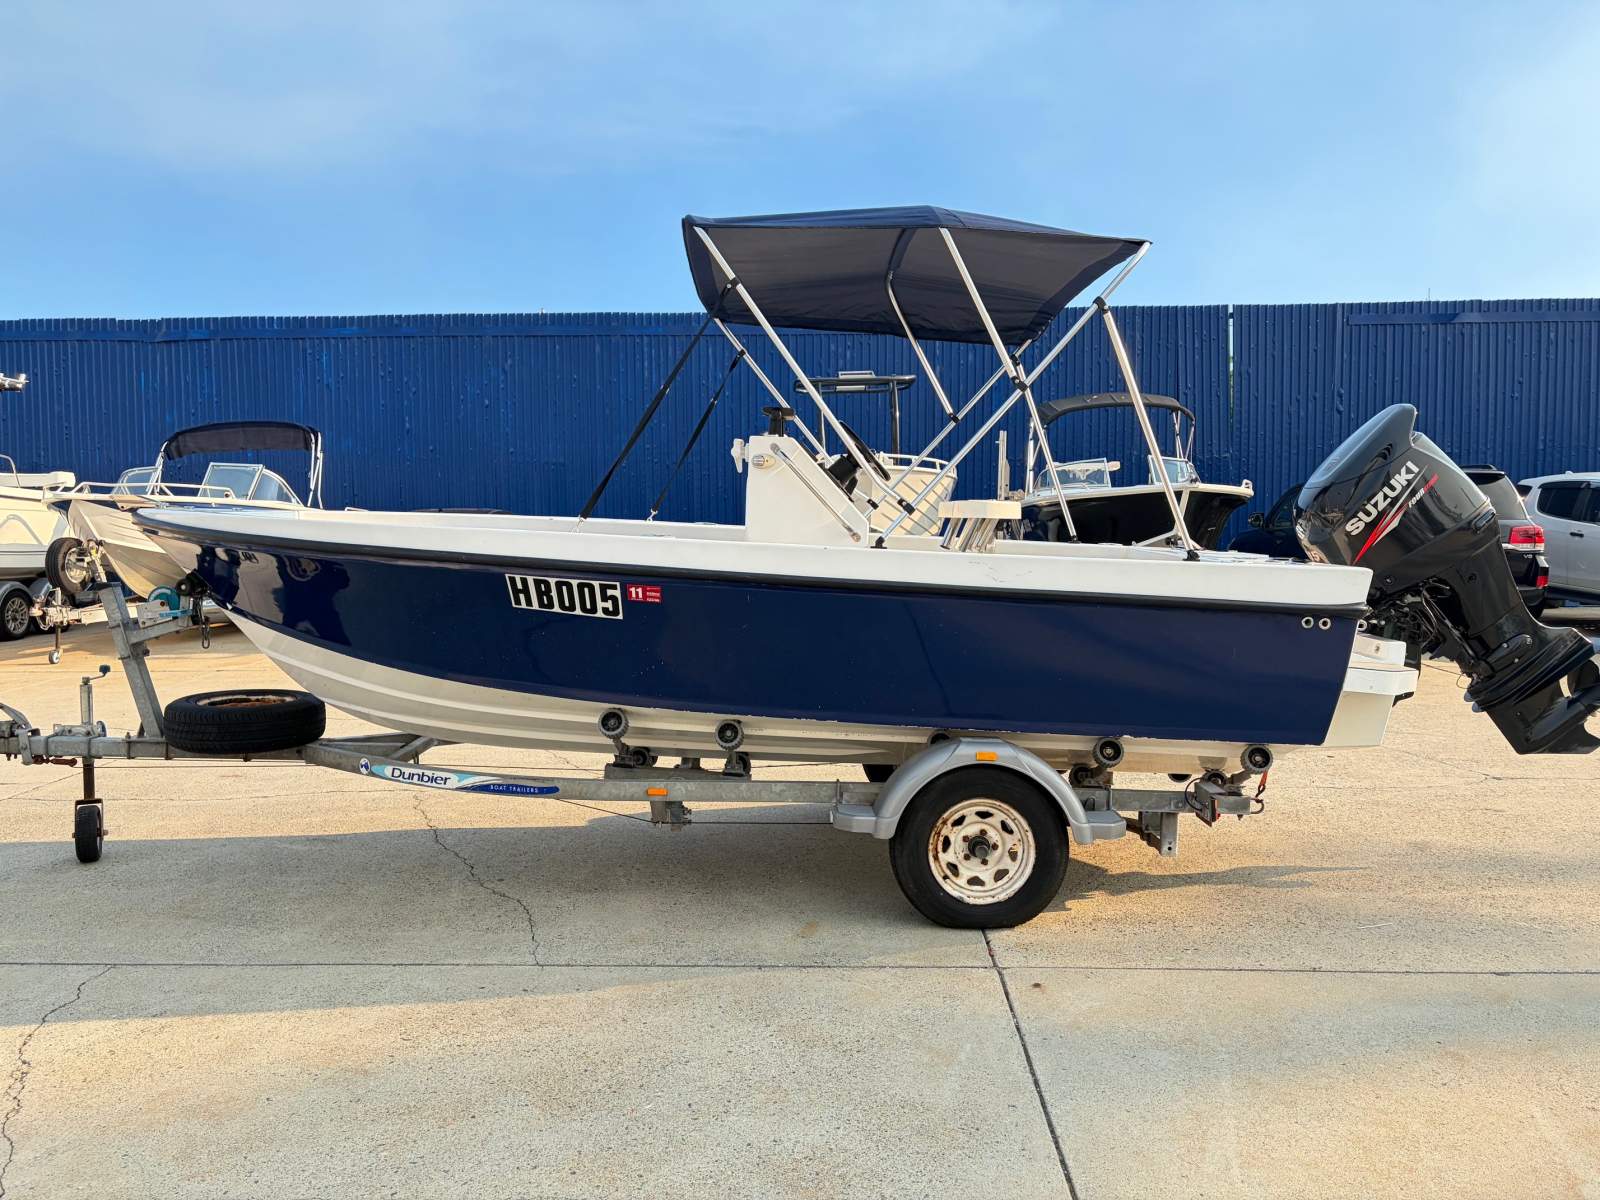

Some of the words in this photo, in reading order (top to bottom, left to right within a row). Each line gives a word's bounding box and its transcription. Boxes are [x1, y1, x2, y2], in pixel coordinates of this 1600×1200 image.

[1345, 460, 1420, 536] SUZUKI
[508, 576, 621, 617] HB005
[629, 587, 643, 599] 11
[391, 767, 451, 786] Dunbier
